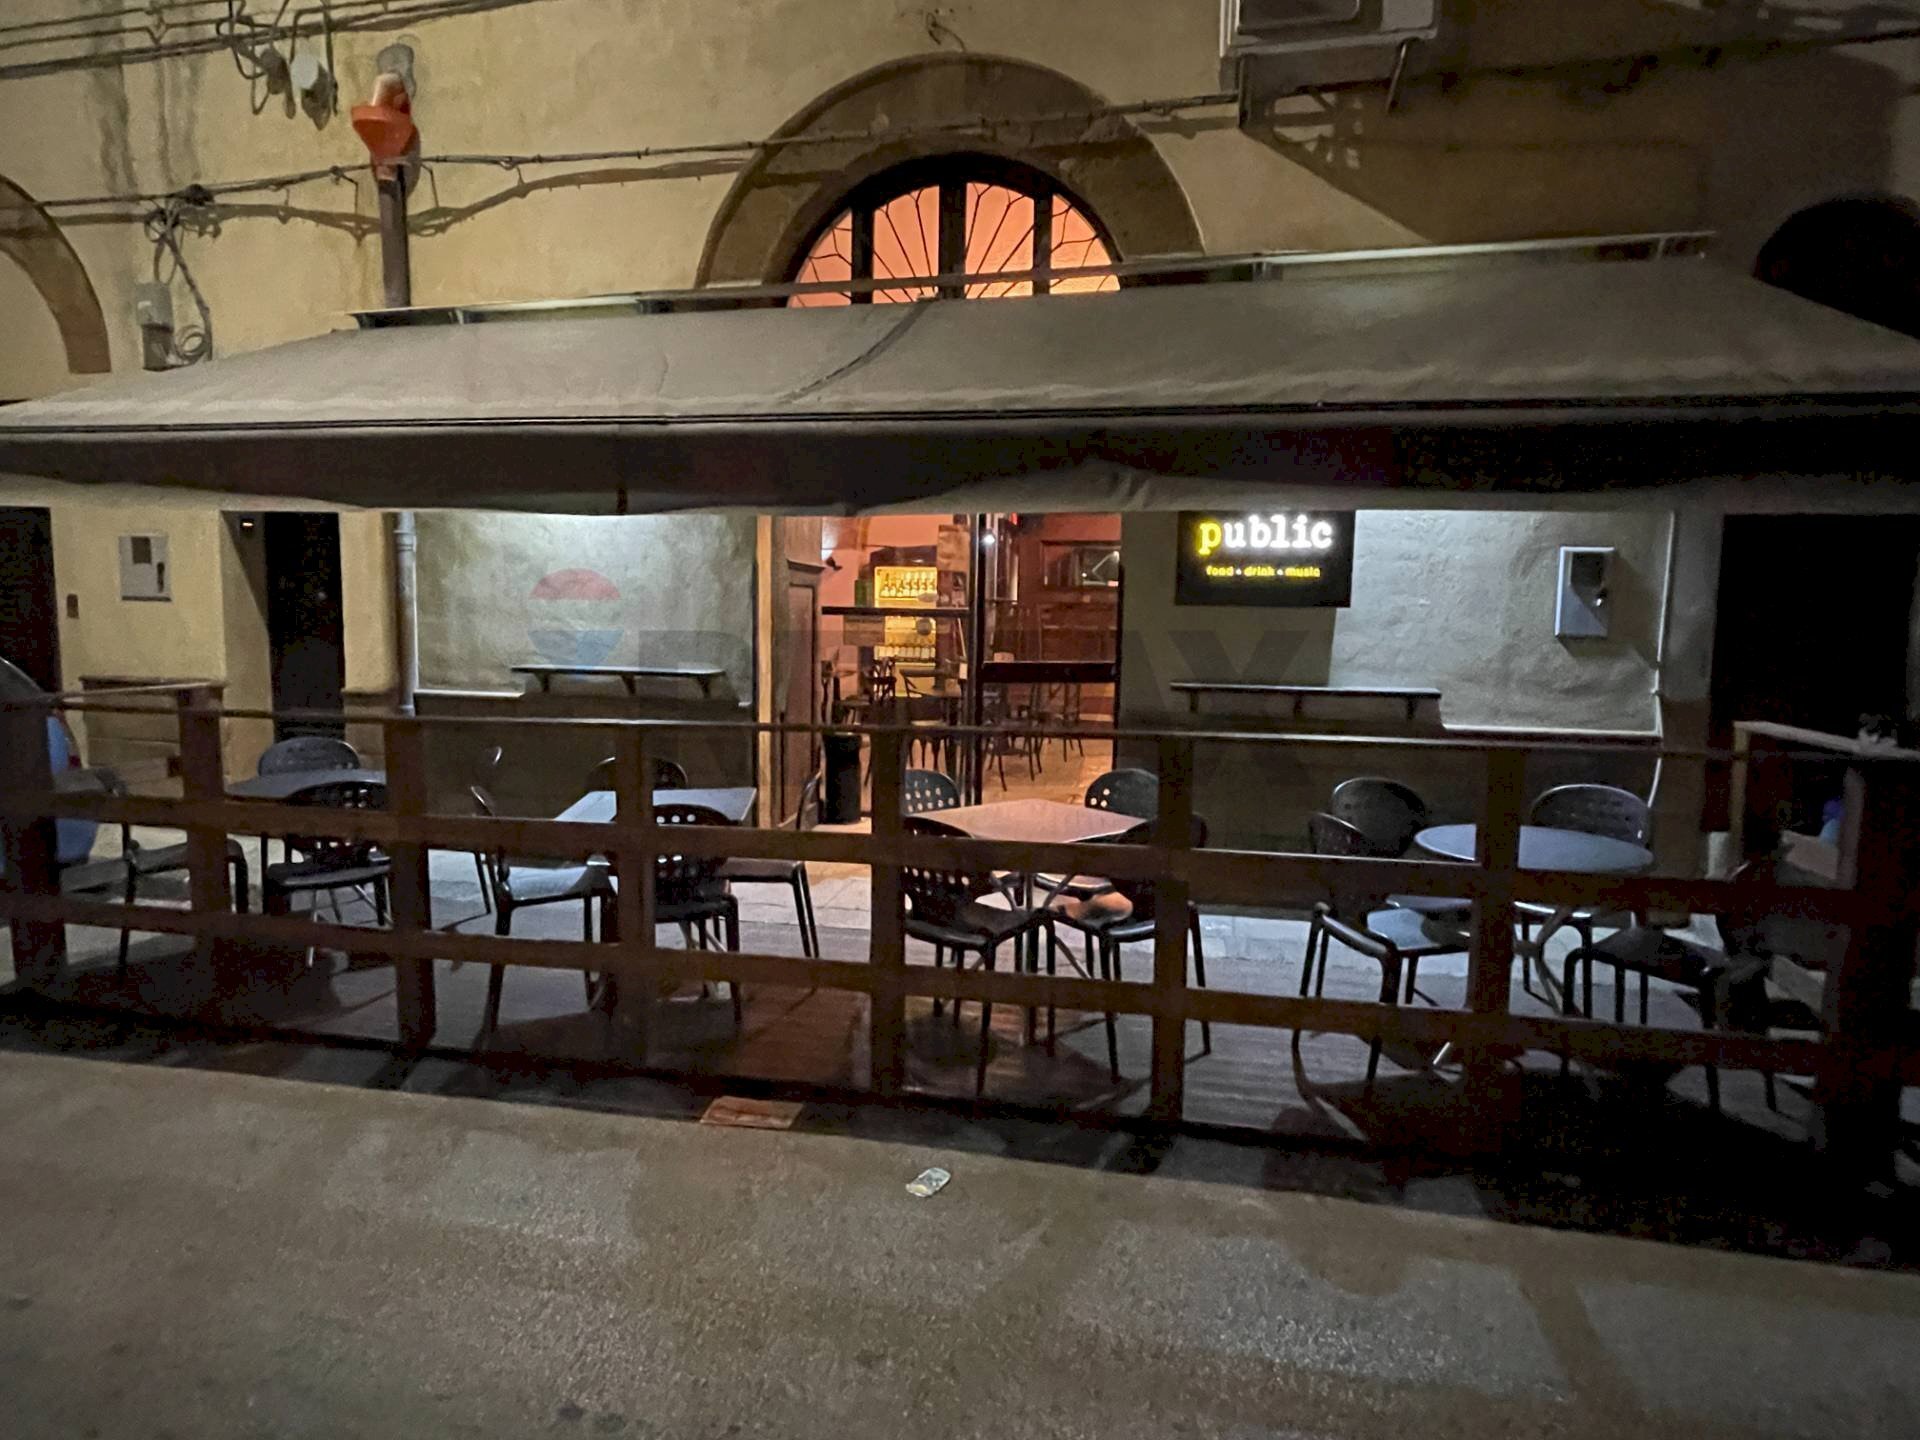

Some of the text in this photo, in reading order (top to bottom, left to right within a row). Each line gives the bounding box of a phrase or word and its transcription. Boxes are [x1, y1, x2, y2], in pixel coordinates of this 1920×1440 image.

[1198, 513, 1333, 556] public
[1206, 565, 1321, 578] food drink music
